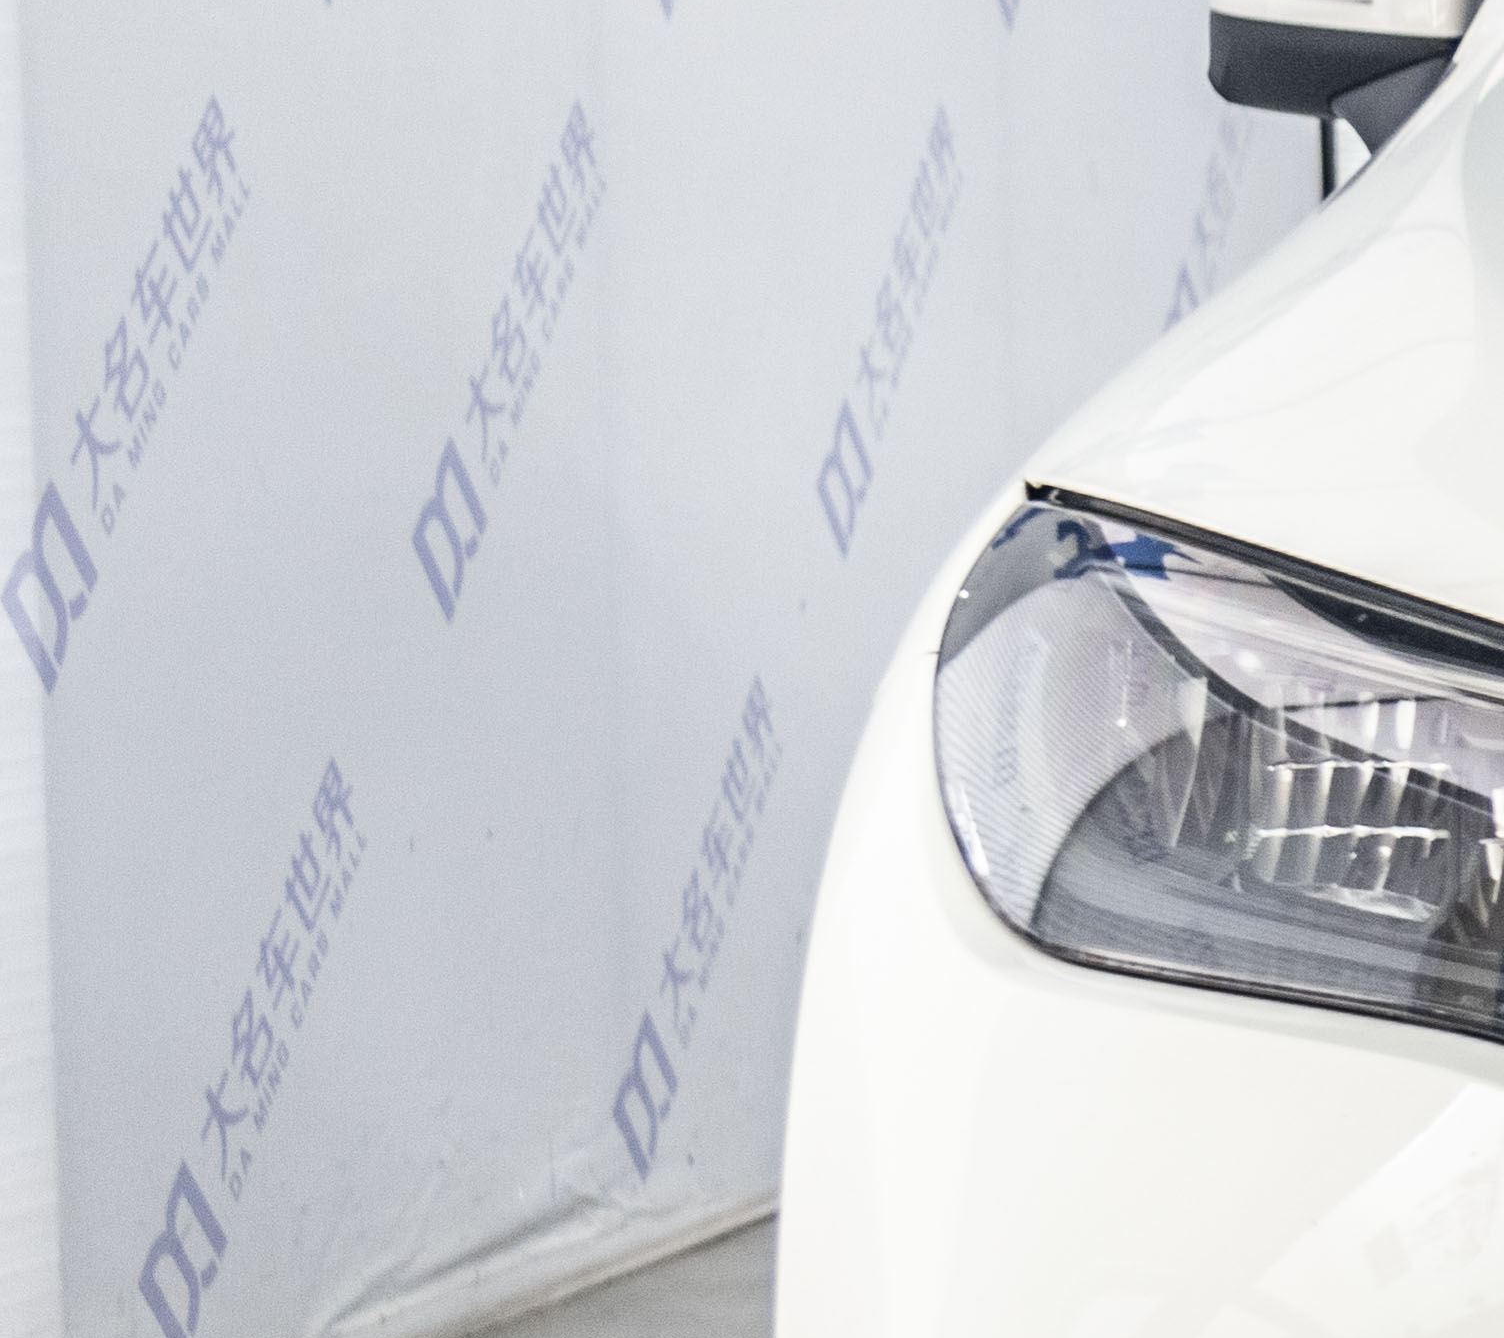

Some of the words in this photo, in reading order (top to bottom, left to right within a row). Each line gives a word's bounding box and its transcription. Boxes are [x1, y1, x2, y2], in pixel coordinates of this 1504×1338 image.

[69, 95, 236, 511] 大名车世界
[100, 481, 126, 537] DA
[125, 377, 168, 470] MING
[166, 277, 210, 372] CARS
[209, 180, 252, 267] MALL
[465, 99, 598, 464] 大名车世界
[200, 754, 354, 1181] 大名车世界
[658, 673, 773, 1031] 大名车世界
[228, 1147, 254, 1202] DA
[254, 1039, 291, 1134] MING
[290, 928, 331, 1031] CARS
